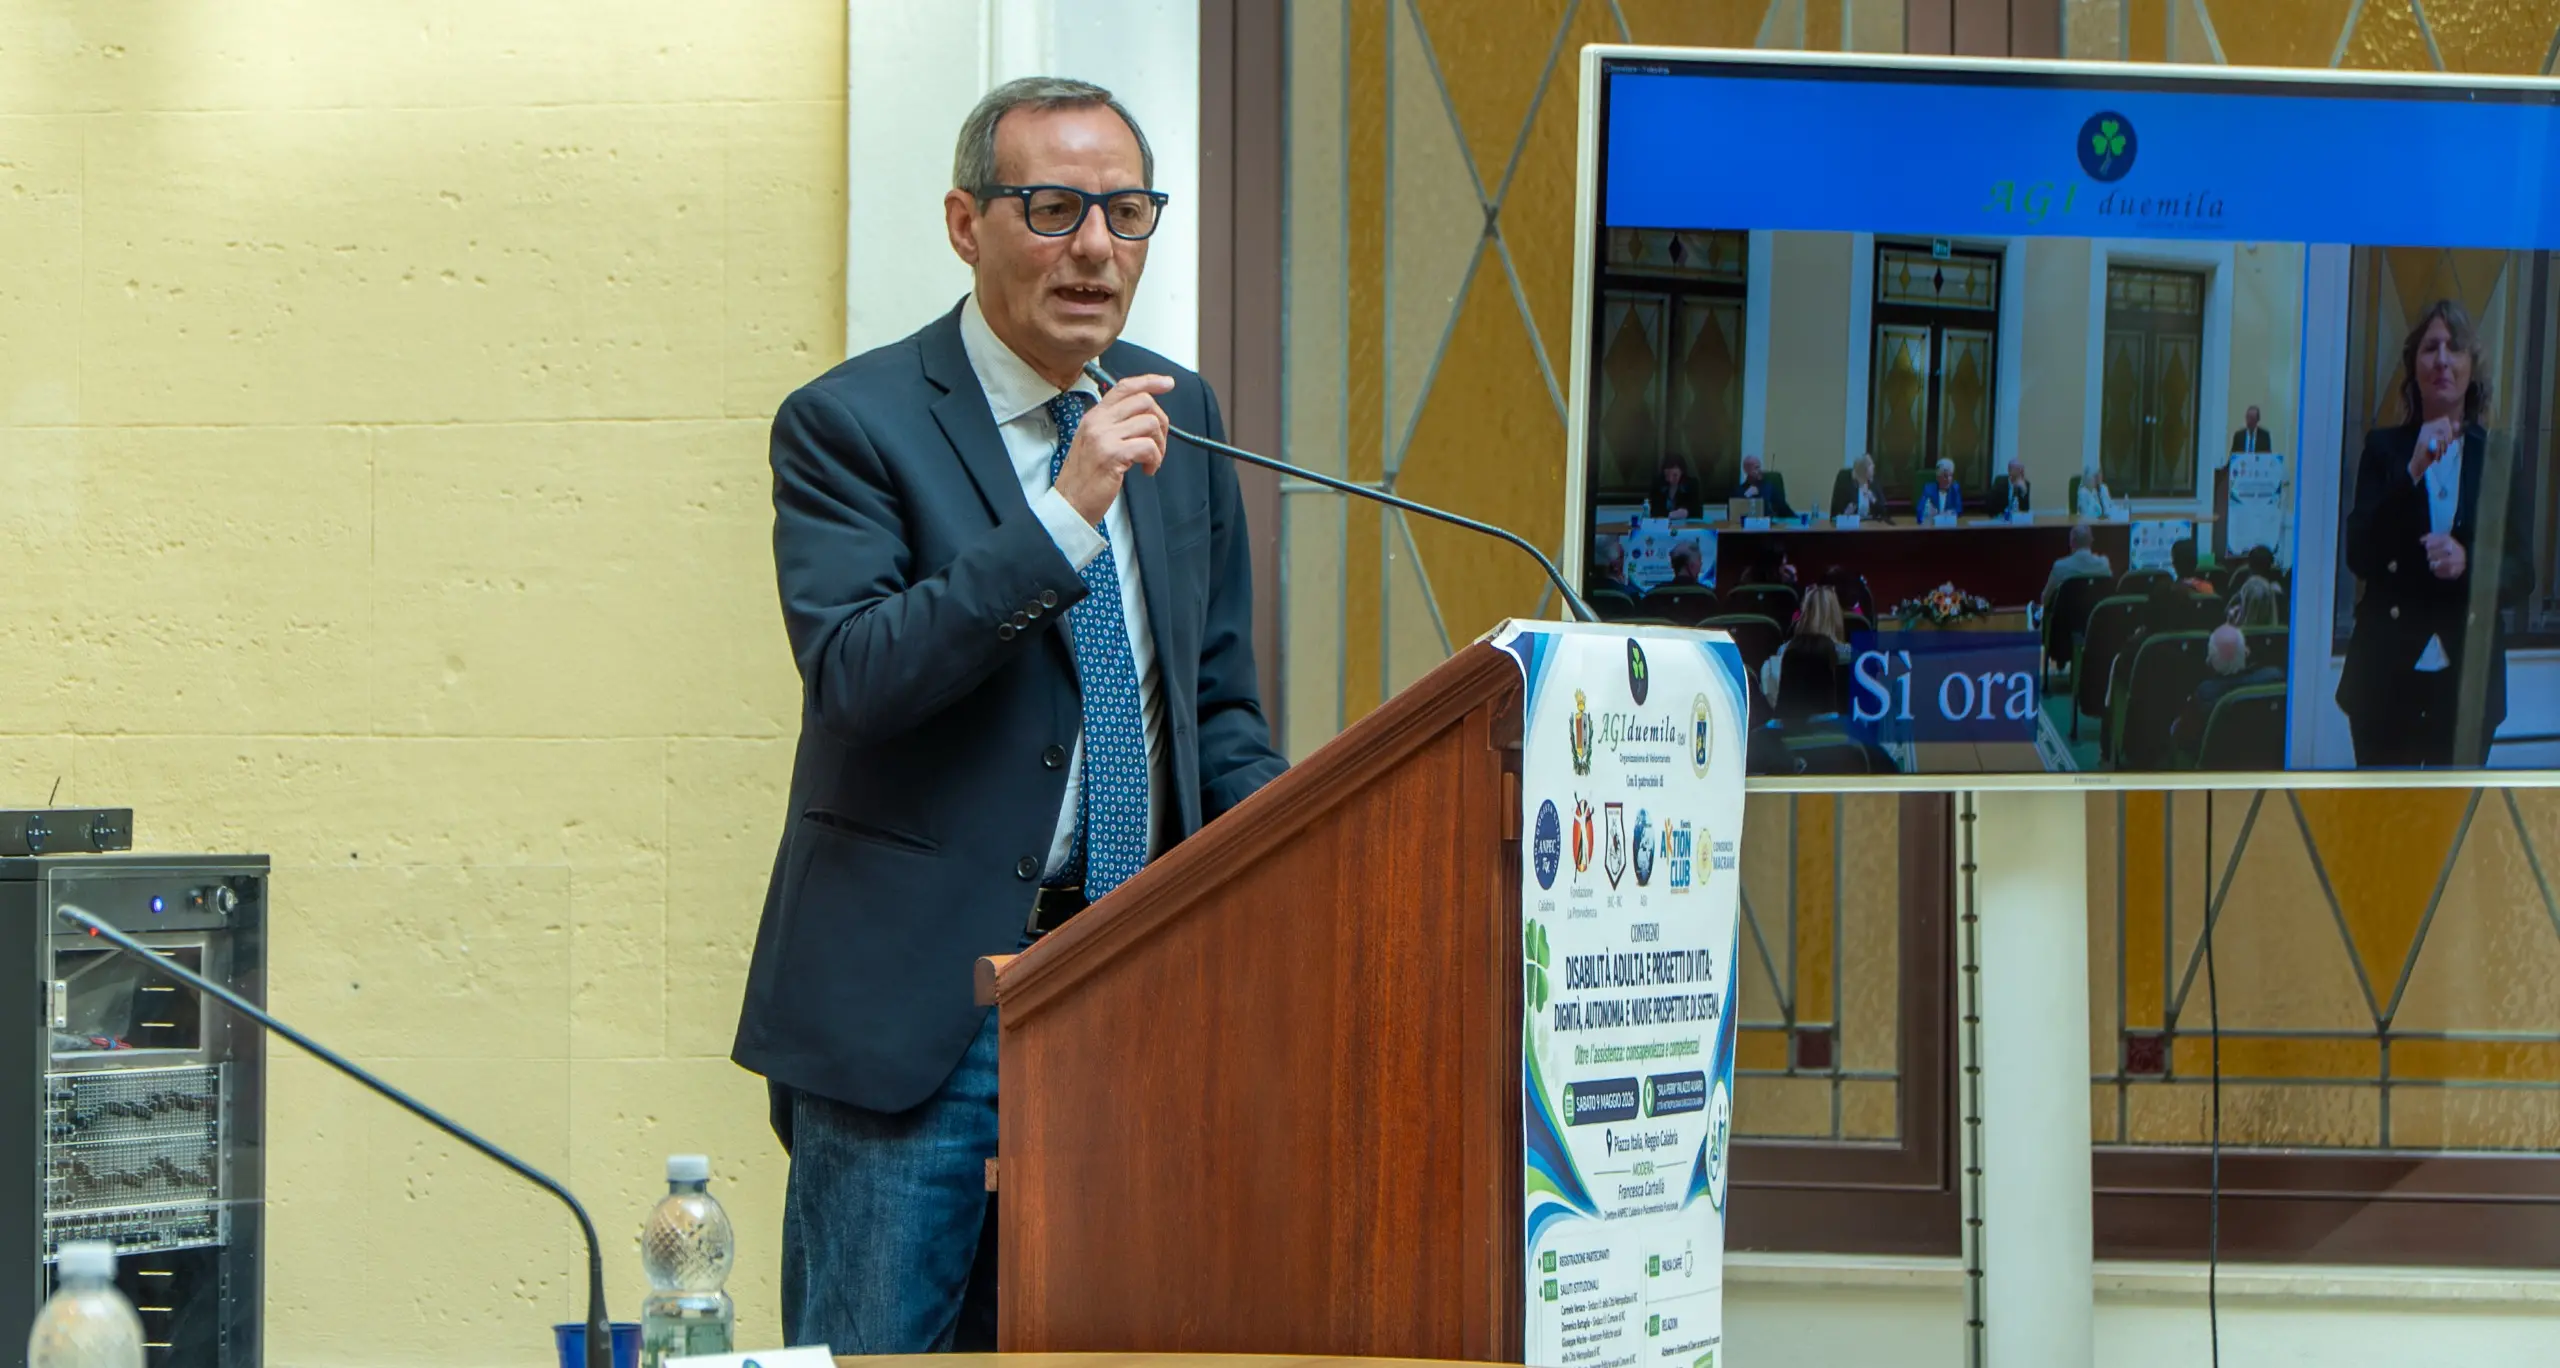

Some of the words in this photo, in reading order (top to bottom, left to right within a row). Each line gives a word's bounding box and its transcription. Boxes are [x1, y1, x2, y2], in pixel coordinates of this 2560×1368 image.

[1982, 181, 2079, 226] AGI
[2098, 188, 2224, 218] duemila
[1853, 650, 1915, 722] Sì
[1938, 672, 2038, 721] ora
[1670, 860, 1690, 887] CLUB
[1631, 923, 1659, 943] CONVEGNO
[1566, 947, 1611, 990] DISABILITÀ
[1613, 953, 1645, 988] ADULTA
[1646, 953, 1651, 986] E
[1652, 950, 1685, 985] PROGETTI
[1687, 950, 1693, 983] DI
[1695, 949, 1712, 982] VITA:
[1554, 995, 1583, 1034] DIGNITÀ,
[1584, 999, 1624, 1030] AUTONOMIA
[1626, 999, 1630, 1026] E
[1632, 997, 1652, 1026] NUOVE
[1653, 995, 1689, 1024] PROSPETTIVE
[1690, 994, 1696, 1022] DI
[1574, 1044, 1589, 1065] Oltre
[1576, 1094, 1595, 1112] SABATO
[1596, 1095, 1600, 1110] 9
[1600, 1093, 1621, 1110] MAGGIO
[1622, 1092, 1635, 1107] 2026
[1614, 1135, 1630, 1152] Piazza
[1644, 1132, 1659, 1152] Reggio
[1660, 1129, 1678, 1147] Calabria
[1618, 1184, 1644, 1200] Francesca
